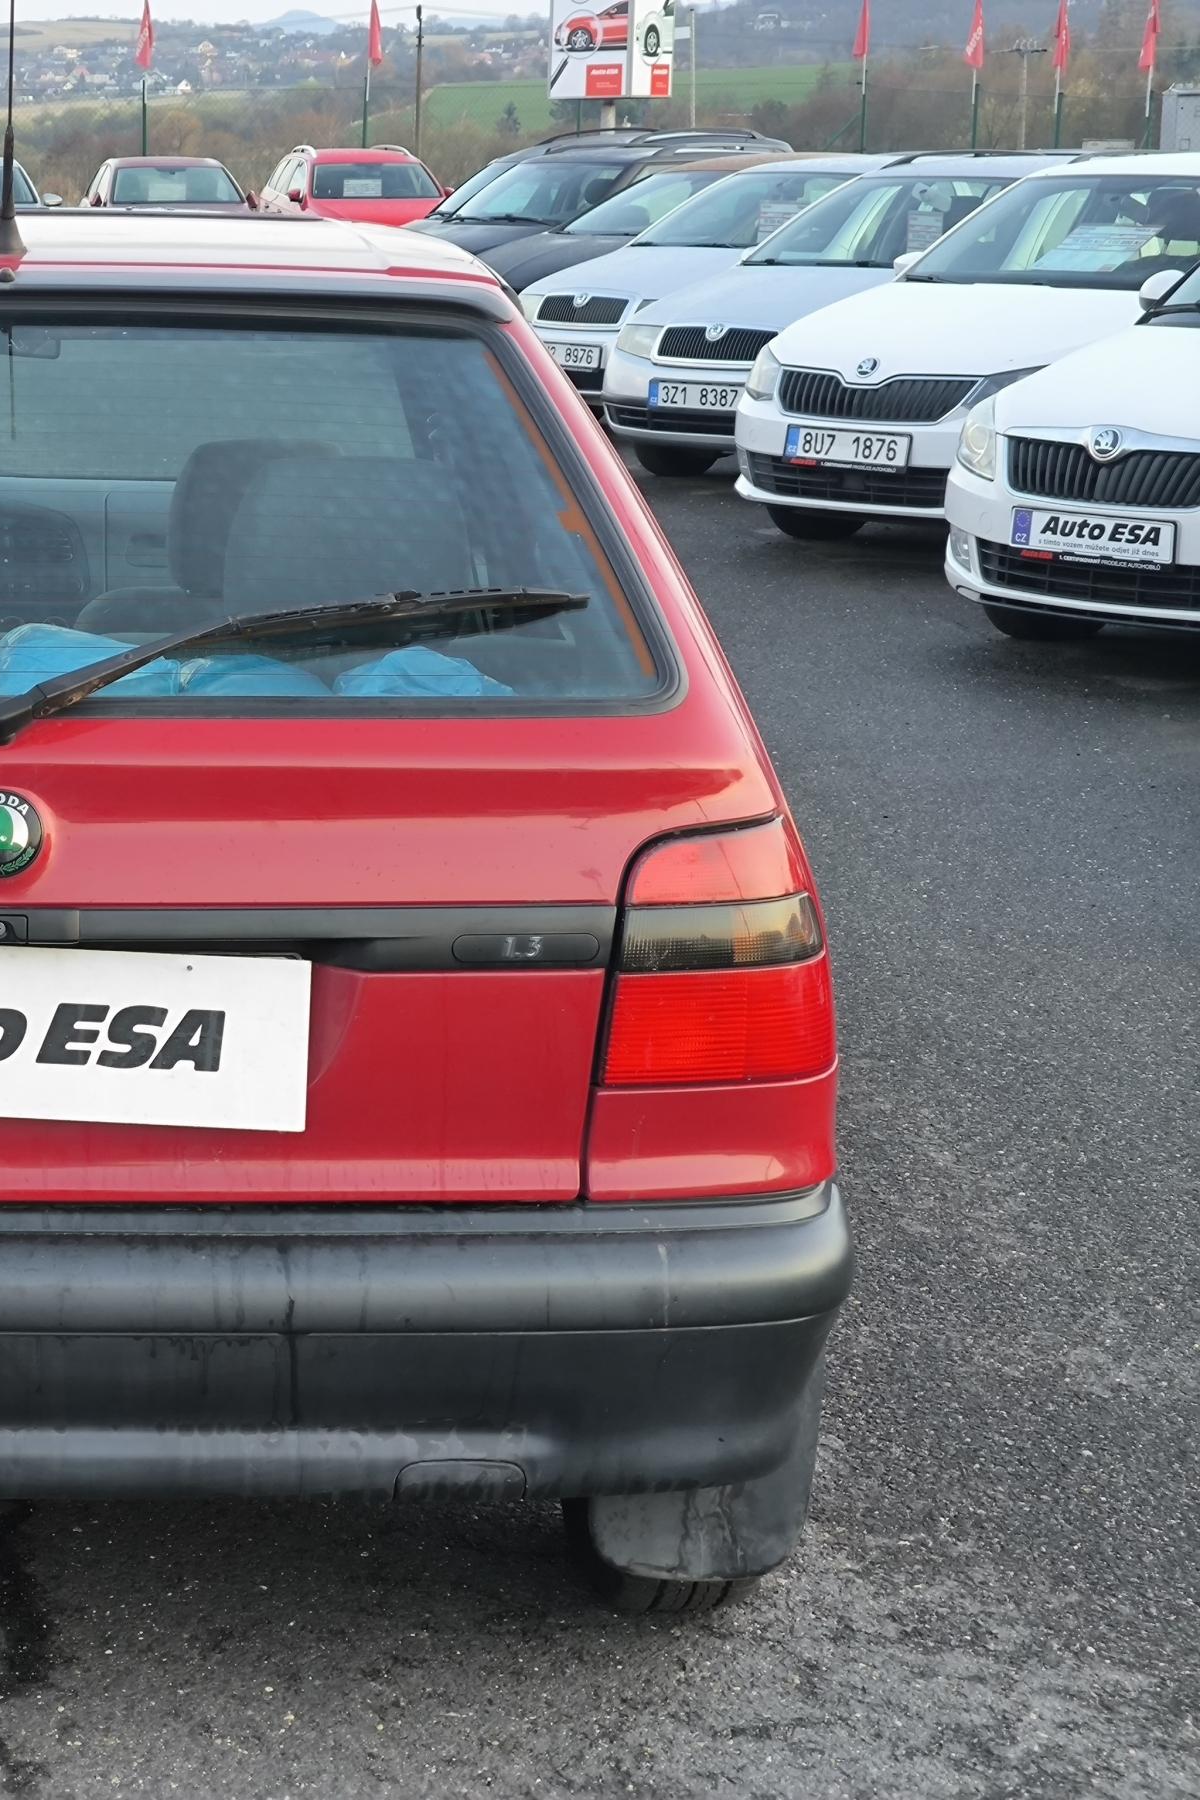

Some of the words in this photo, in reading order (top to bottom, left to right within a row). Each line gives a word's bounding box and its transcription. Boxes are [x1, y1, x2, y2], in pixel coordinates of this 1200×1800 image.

[564, 347, 594, 365] 8976
[662, 385, 687, 405] 3Z1
[700, 388, 738, 407] 8387
[802, 432, 836, 456] 8U7
[852, 436, 898, 461] 1876
[1015, 532, 1027, 543] CZ
[1039, 515, 1106, 540] Auto
[1108, 522, 1162, 546] ESA
[1062, 541, 1084, 549] vozem
[1141, 549, 1160, 557] dnes
[35, 1002, 227, 1073] ESA
